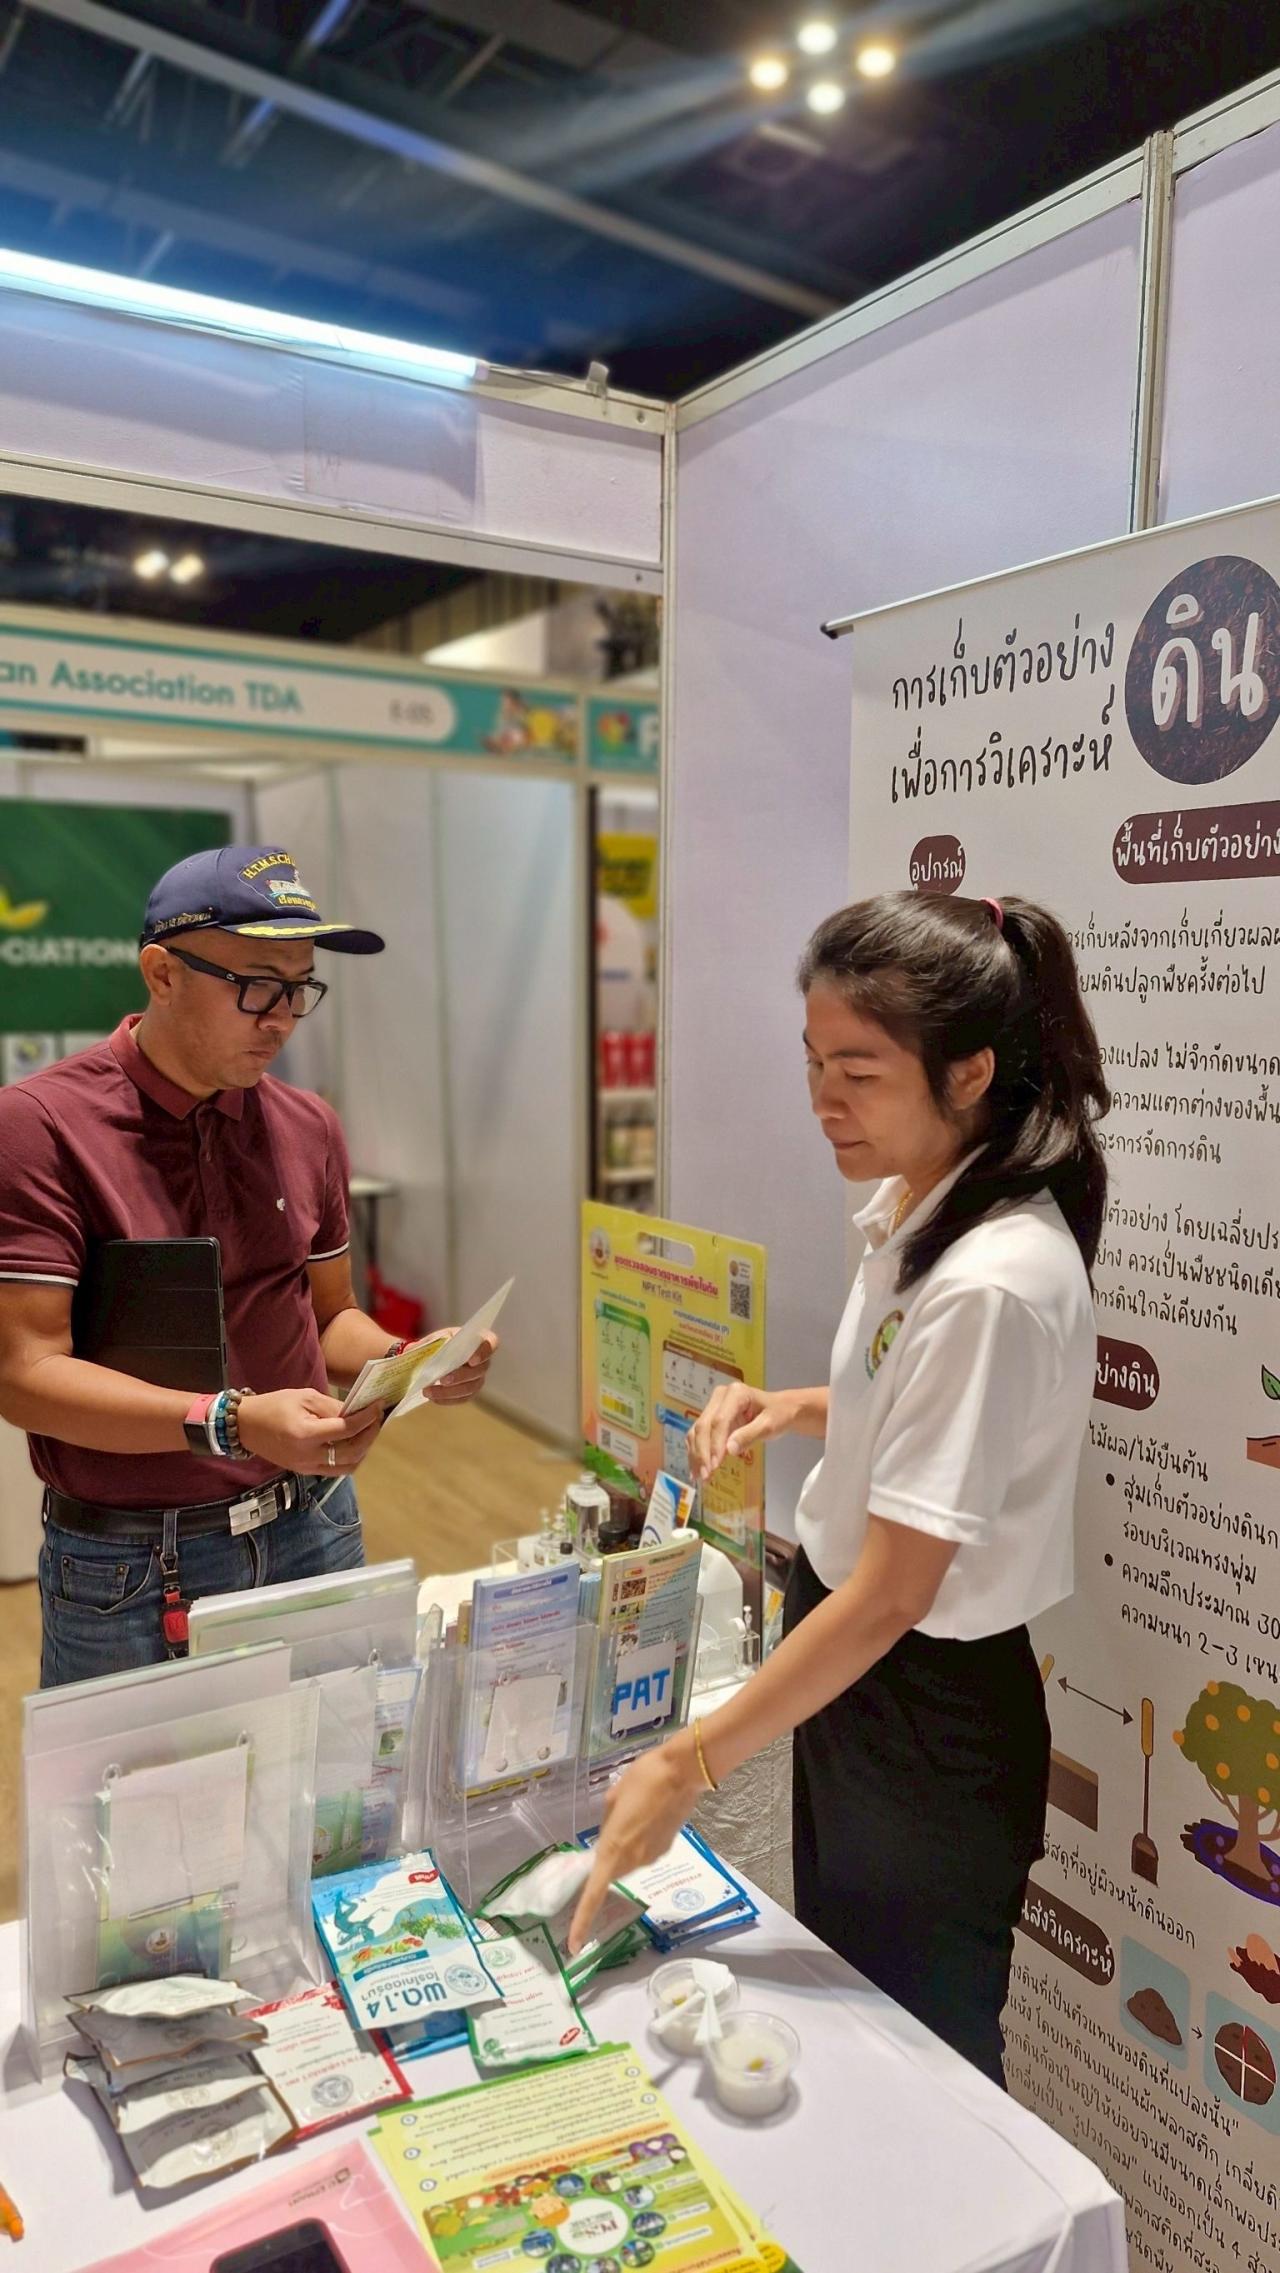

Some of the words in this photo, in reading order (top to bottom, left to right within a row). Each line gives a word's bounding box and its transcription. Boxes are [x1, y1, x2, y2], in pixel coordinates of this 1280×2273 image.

[51, 661, 235, 706] Association
[243, 681, 303, 713] TDA
[893, 613, 1114, 711] การเก็บตัวอย่าง
[1151, 592, 1266, 729] ดิน
[890, 684, 1115, 803] เพื่อการวิเคราะห์
[0, 937, 139, 966] CIATION
[1122, 1563, 1250, 1626] ความลึกประมาณ
[1121, 1604, 1191, 1648] ความหนา
[611, 1668, 670, 1715] PAT
